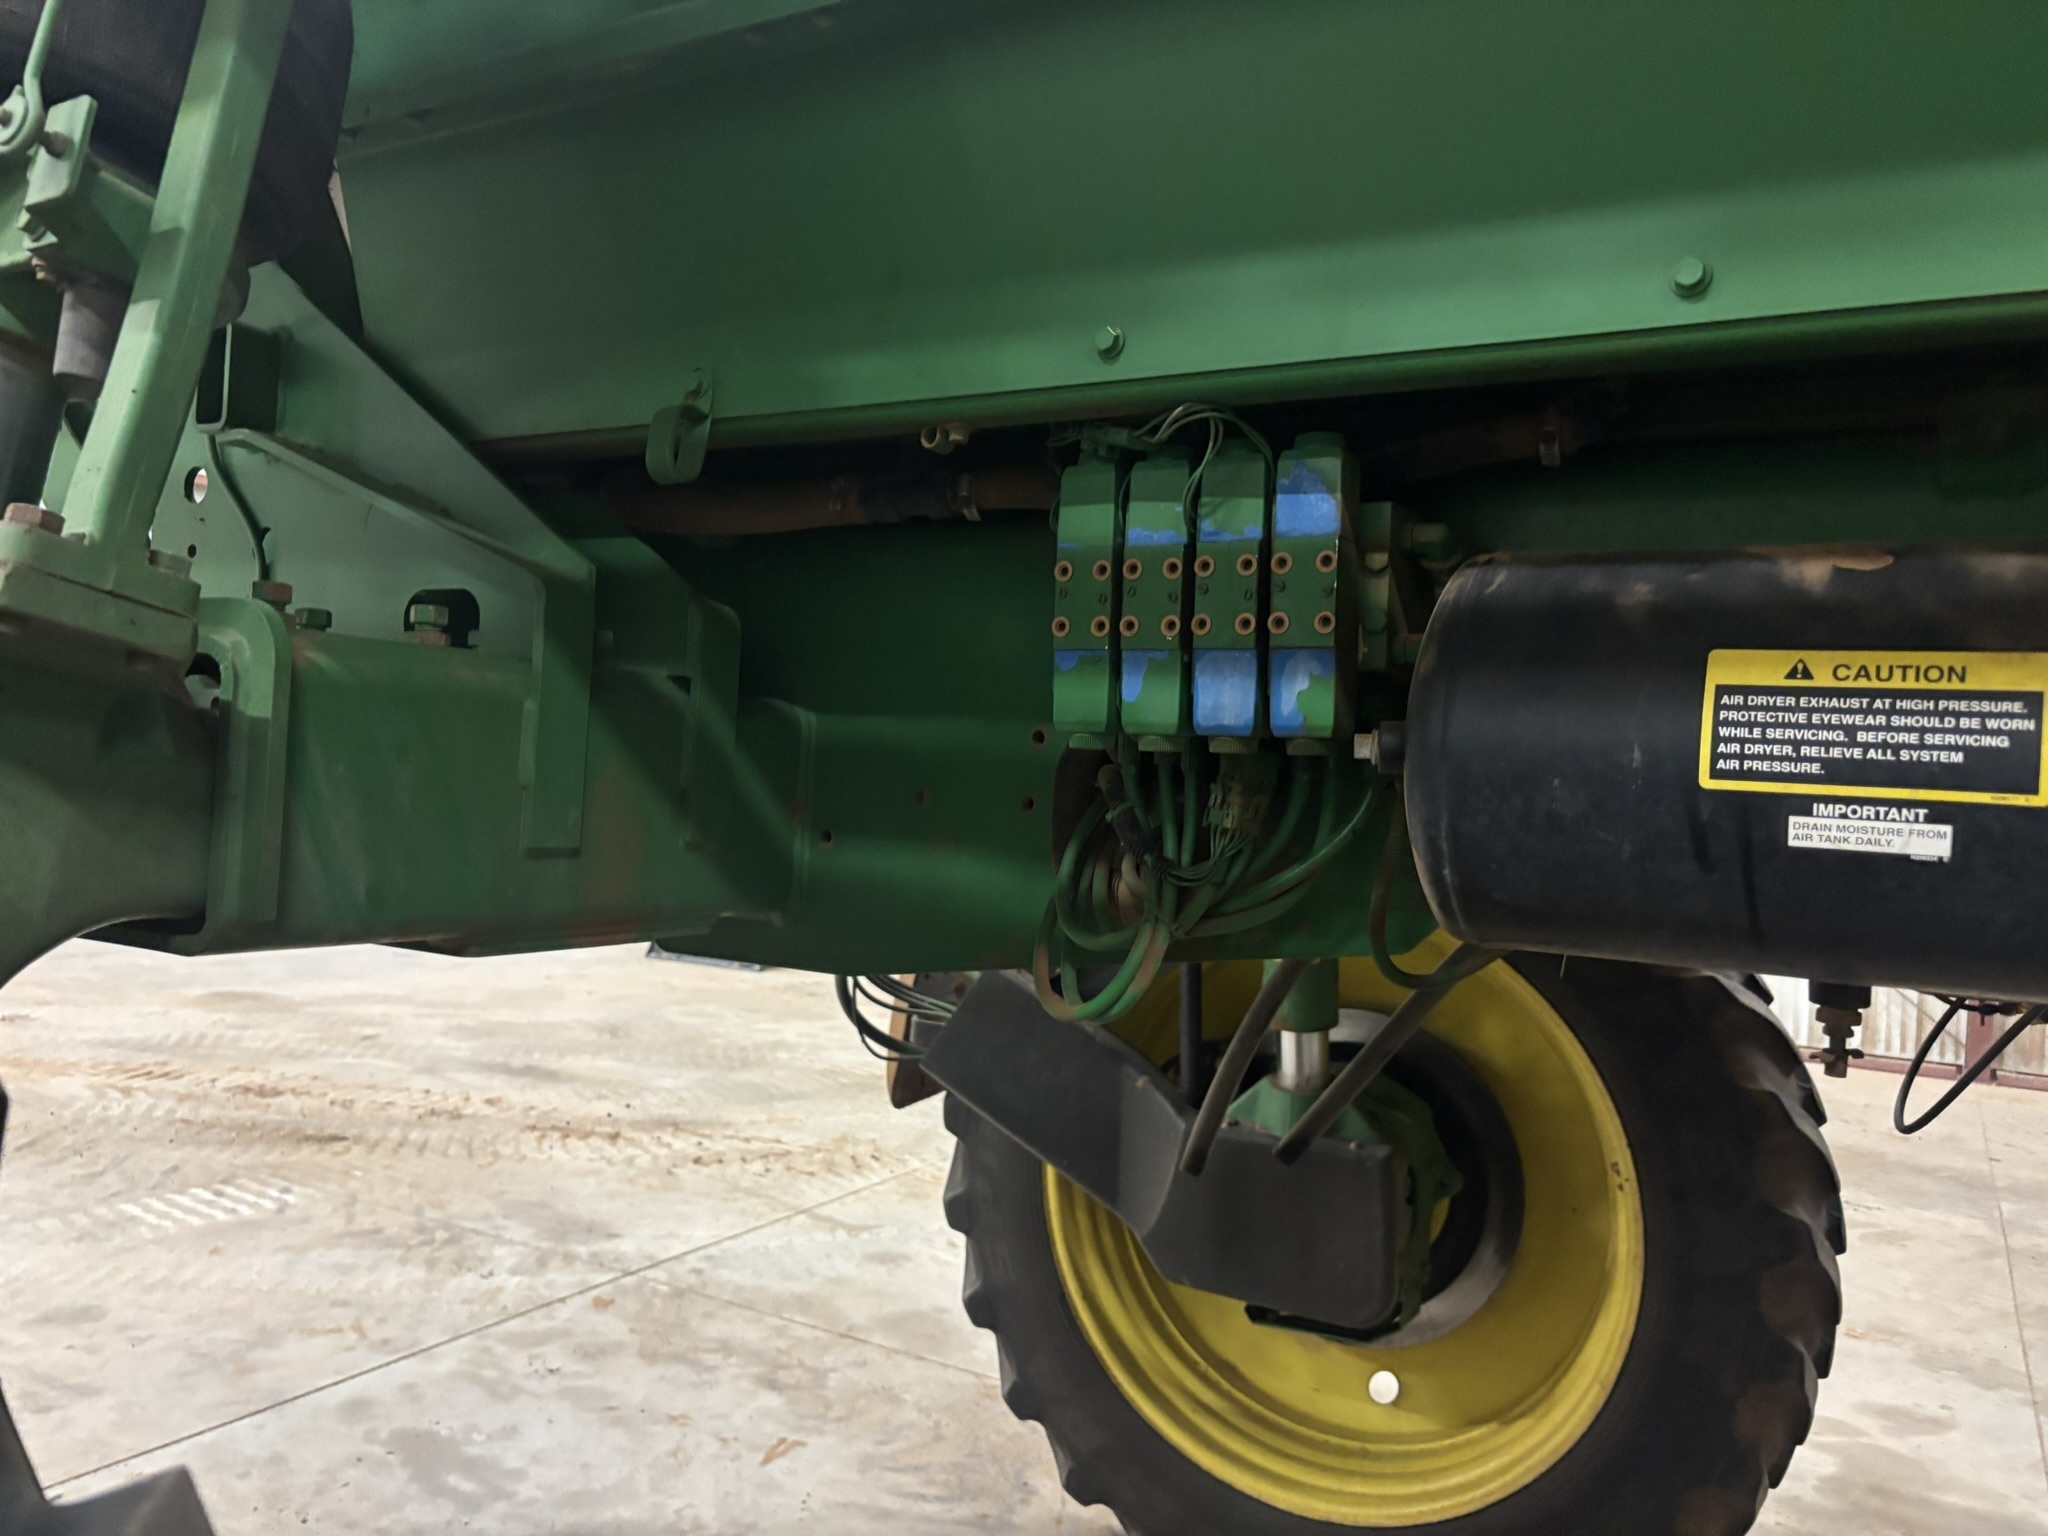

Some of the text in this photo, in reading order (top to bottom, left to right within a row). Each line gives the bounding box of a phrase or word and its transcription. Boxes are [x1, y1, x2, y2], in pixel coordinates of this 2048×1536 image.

[1832, 664, 1966, 683] CAUTION
[1720, 695, 2027, 713] AIR DRYER EXHAUST AT HIGH PRESSURE.
[1719, 711, 2035, 731] PROTECTIVE EYEWEAR SHOULD BE WORN
[1718, 726, 2010, 747] WHILE SERVICING. BEFORE SERVICING
[1717, 743, 1964, 763] AIR DRYER, RELIEVE ALL SYSTEM
[1716, 759, 1824, 774] AIR PRESSURE.
[1813, 803, 1928, 822] IMPORTANT
[1793, 821, 1947, 840] DRAIN MOISTURE FROM
[1792, 833, 1895, 848] AIR TANK DAILY.
